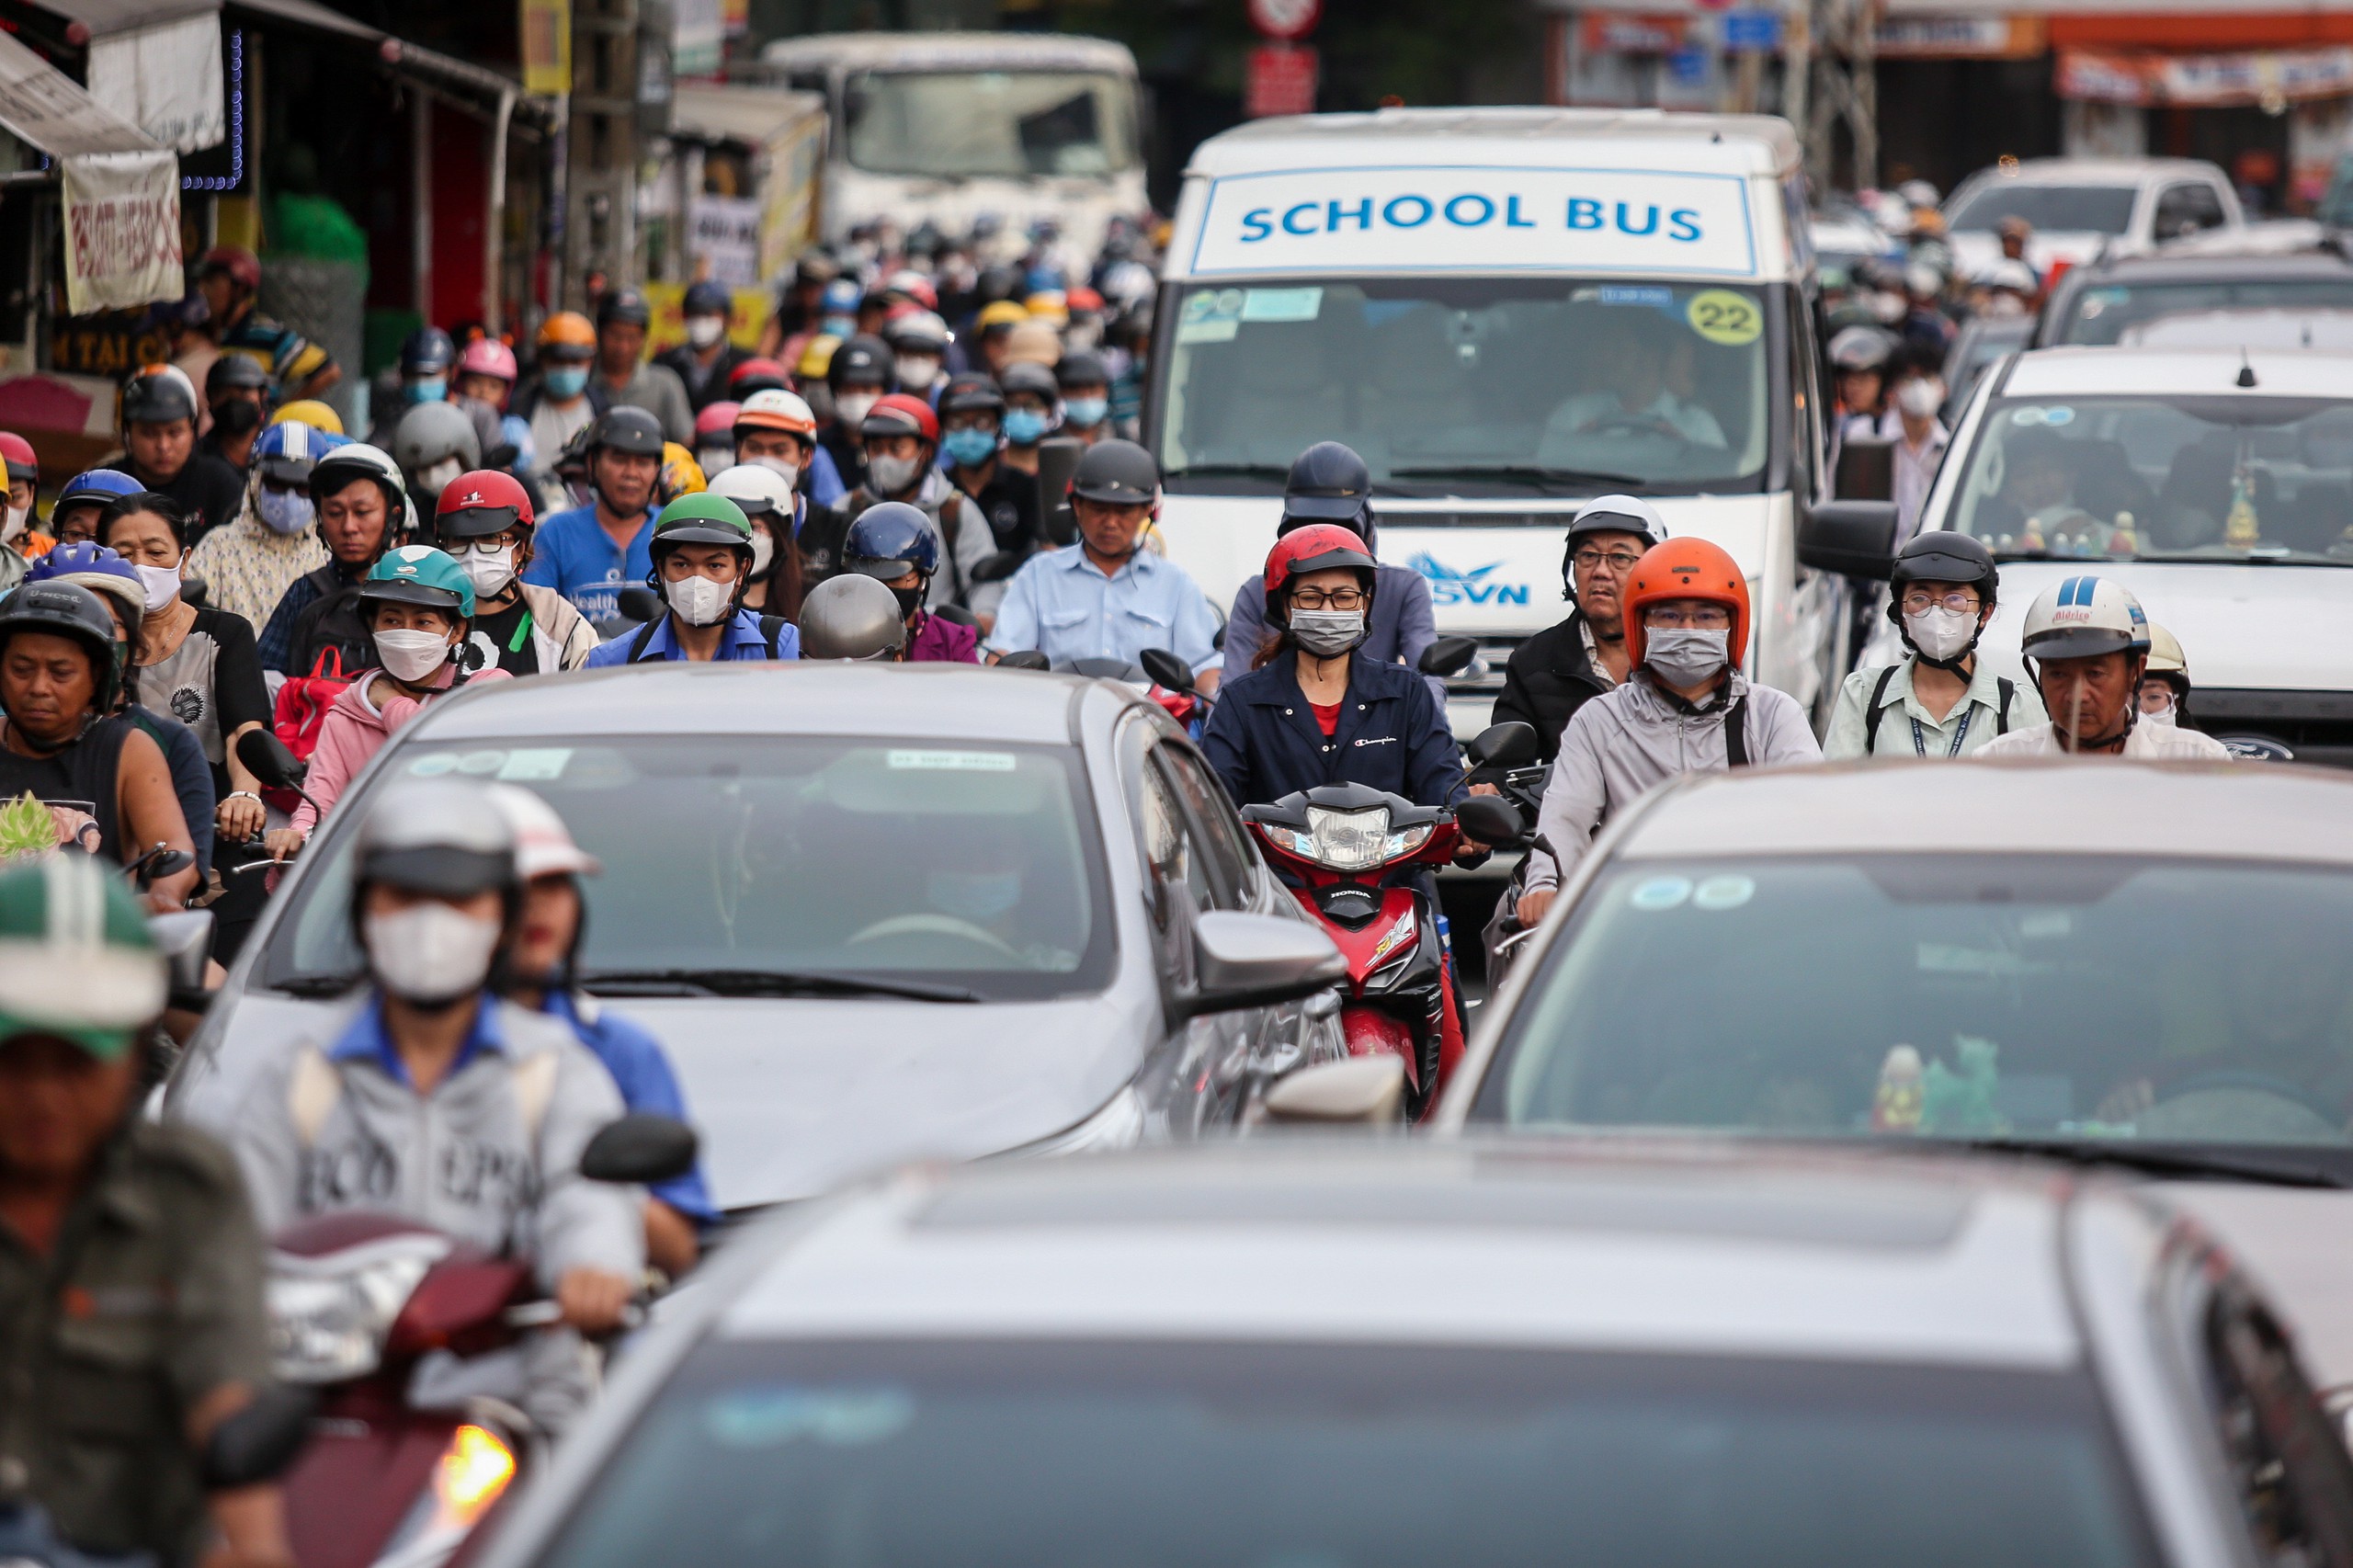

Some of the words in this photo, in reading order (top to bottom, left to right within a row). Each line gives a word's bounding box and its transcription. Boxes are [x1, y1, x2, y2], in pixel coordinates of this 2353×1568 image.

[1241, 194, 1537, 242] SCHOOL
[1567, 198, 1703, 242] BUS
[1699, 301, 1754, 333] 22
[1355, 736, 1397, 746] Champion
[1331, 890, 1372, 899] HONDA
